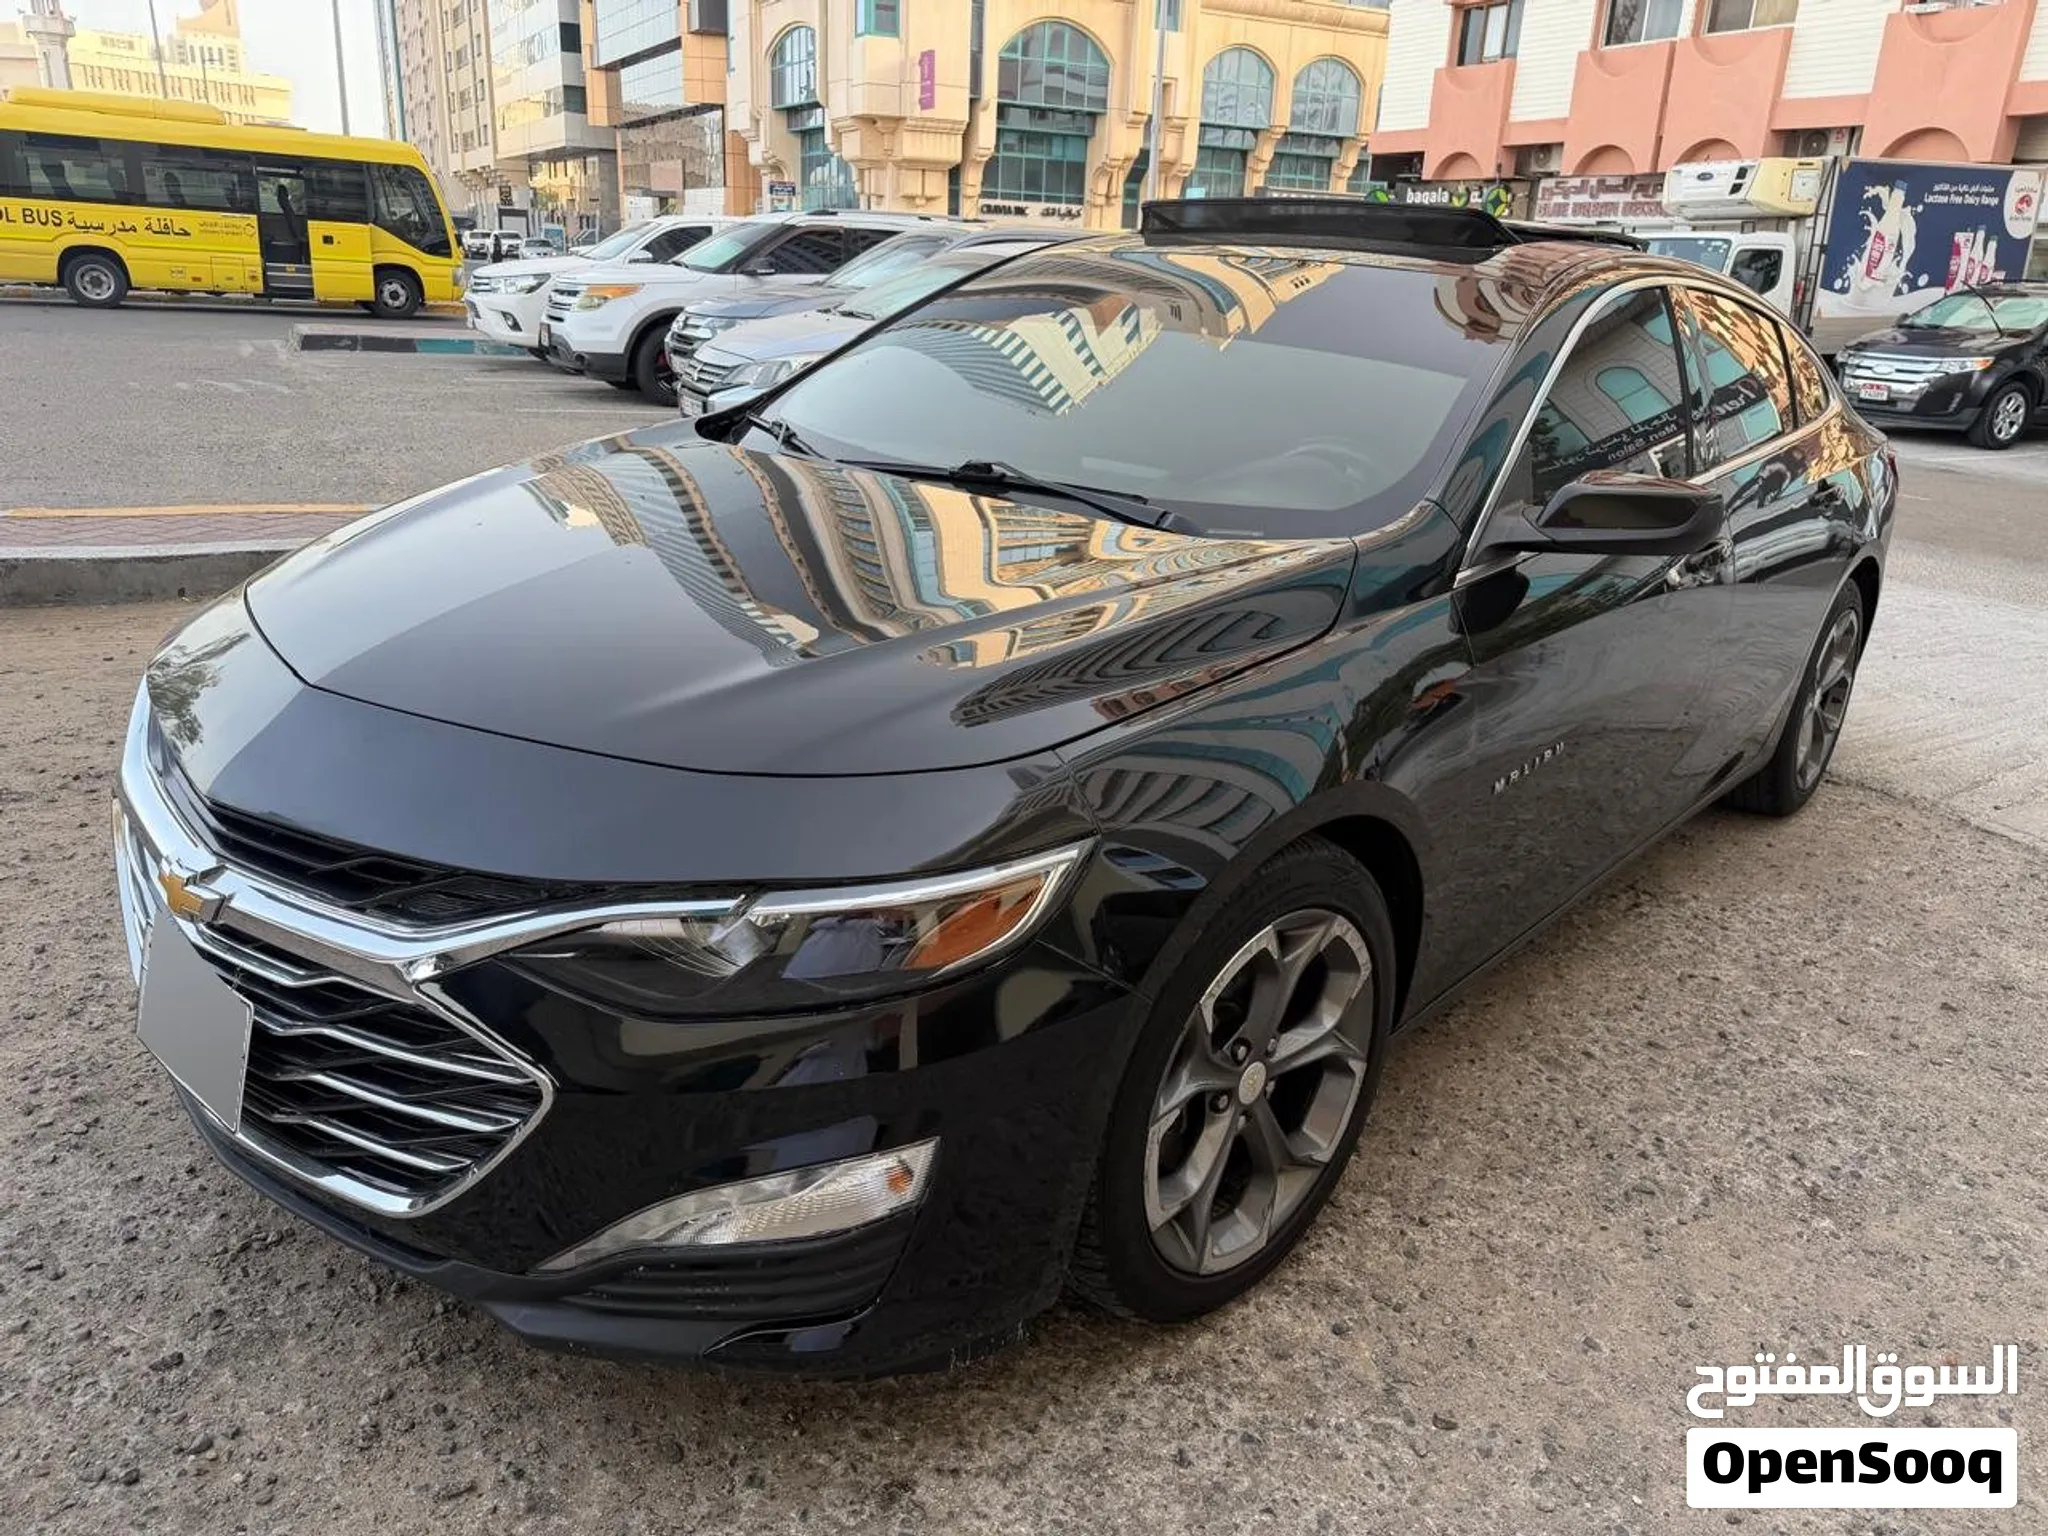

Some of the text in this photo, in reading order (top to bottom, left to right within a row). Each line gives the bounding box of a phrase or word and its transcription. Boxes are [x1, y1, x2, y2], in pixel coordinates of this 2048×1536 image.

[1406, 187, 1449, 205] baqala
[22, 208, 63, 226] BUS
[67, 212, 191, 237] حافلة مدرسية
